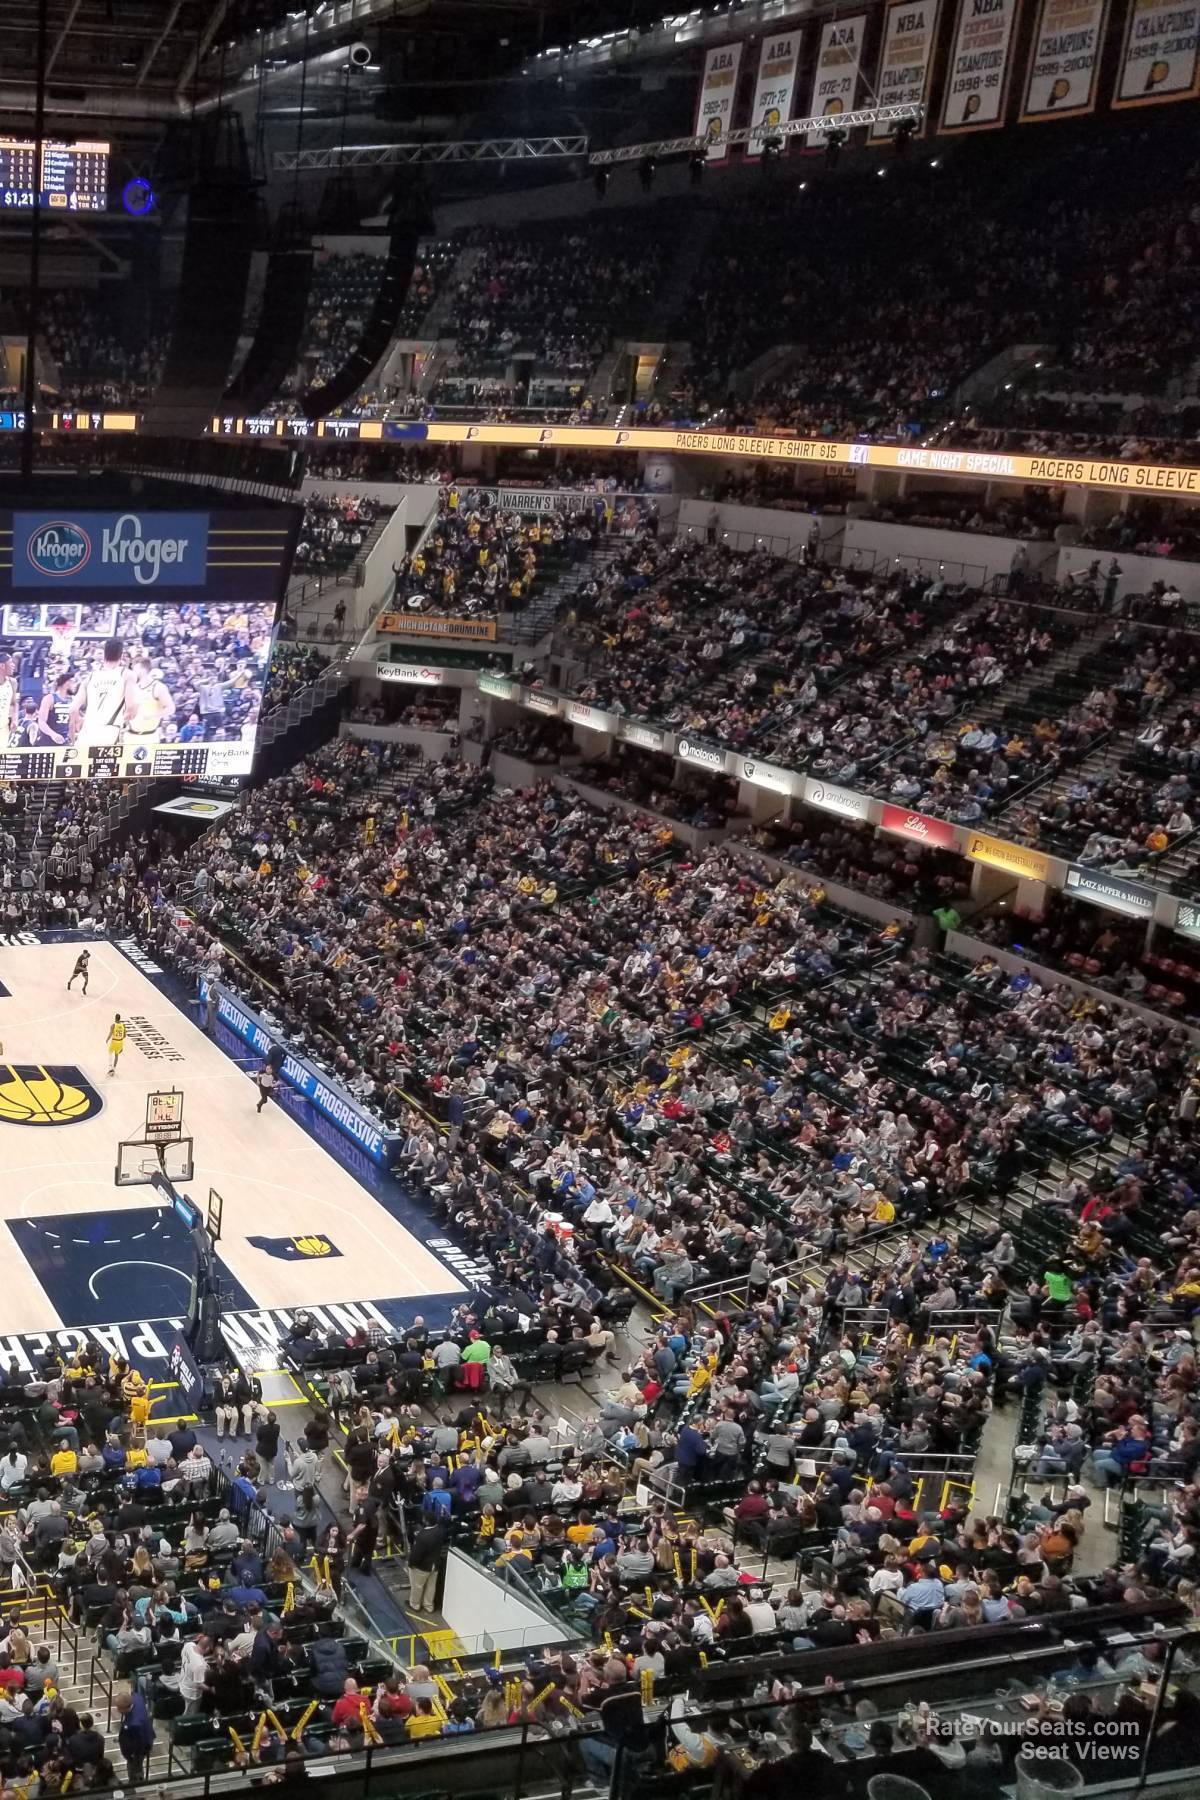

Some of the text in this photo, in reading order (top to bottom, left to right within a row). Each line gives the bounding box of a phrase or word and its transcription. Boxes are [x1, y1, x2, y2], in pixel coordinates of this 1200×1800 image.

[896, 12, 925, 34] NBA
[1135, 8, 1196, 39] CHAMPIONS
[829, 26, 855, 47] ABA
[1039, 29, 1094, 58] CHAMPIONS
[768, 41, 791, 60] ABA
[711, 53, 733, 71] ABA
[64, 420, 71, 429] 2
[93, 419, 100, 429] 7
[224, 424, 231, 433] 2
[250, 425, 270, 434] 2/10
[293, 427, 308, 436] 1/6
[334, 427, 349, 438] 1/1
[676, 434, 838, 459] PACERS LONG SLEEVE T-SHIRT $15
[896, 450, 1016, 475] GAME NIGHT SPECIAL
[1030, 460, 1198, 490] PACERS LONG SLEEVE
[502, 494, 551, 509] WARREN'S
[37, 530, 85, 569] Kroger
[101, 514, 189, 585] Kroger
[376, 666, 418, 678] KeyBank
[55, 714, 70, 724] 32
[97, 747, 122, 758] 7:43
[211, 748, 250, 757] KeyBank
[688, 746, 720, 764] motorola
[64, 766, 73, 777] 9
[134, 764, 143, 775] 6
[824, 791, 860, 810] ambrose
[904, 815, 929, 839] Lilly
[1080, 877, 1152, 908] KATZ SAPPER & MILLER
[129, 1015, 170, 1046] BANKERS
[159, 1047, 186, 1062] LIFE
[313, 1084, 382, 1153] PROGRESSIVE
